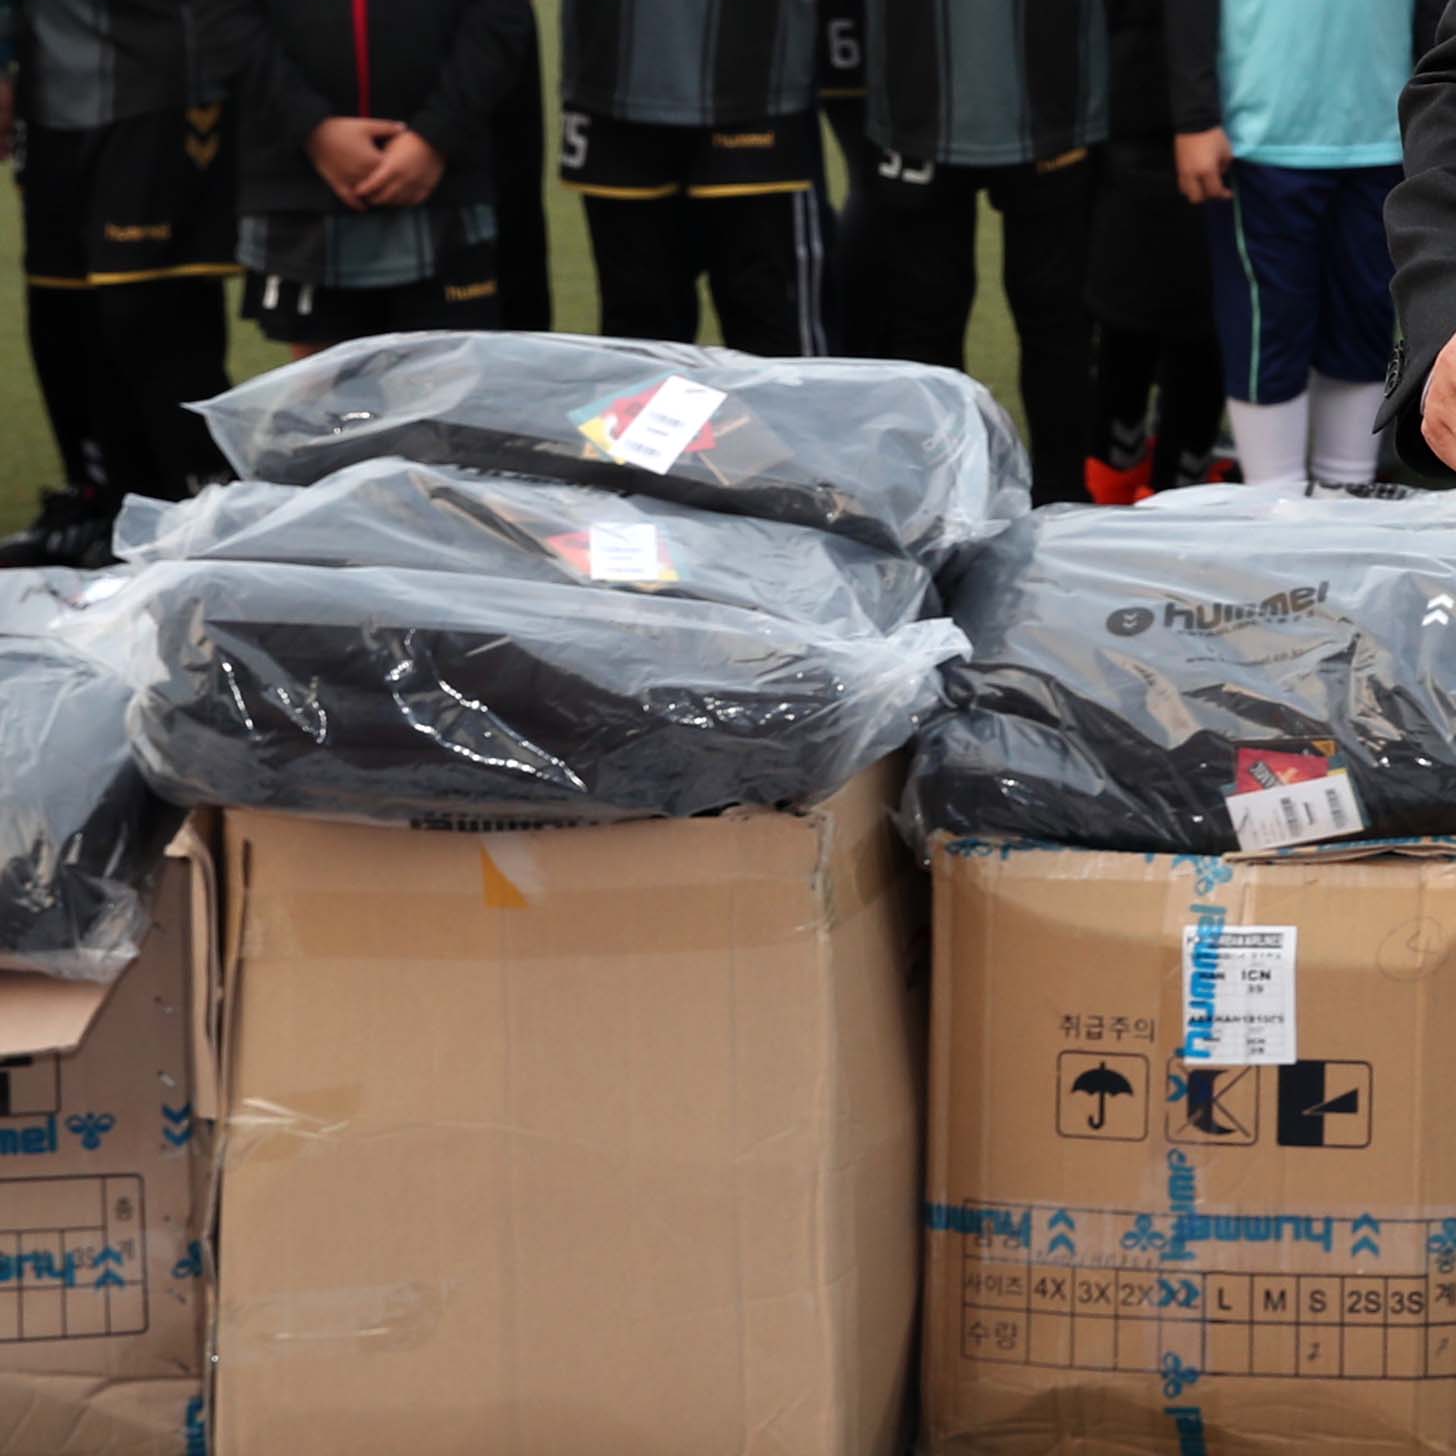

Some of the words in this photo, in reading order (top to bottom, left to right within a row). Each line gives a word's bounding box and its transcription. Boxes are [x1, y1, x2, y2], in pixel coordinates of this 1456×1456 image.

[828, 18, 861, 70] 6
[1241, 969, 1272, 981] ICN
[1058, 1012, 1156, 1044] 취급주의
[1033, 1276, 1066, 1301] 4X
[1077, 1279, 1112, 1304] 3X
[1120, 1282, 1154, 1307] 2X
[1217, 1287, 1233, 1311] L
[1263, 1289, 1287, 1312] M
[1308, 1289, 1327, 1314] S
[1347, 1290, 1383, 1315] 2S
[1390, 1291, 1425, 1316] 3S
